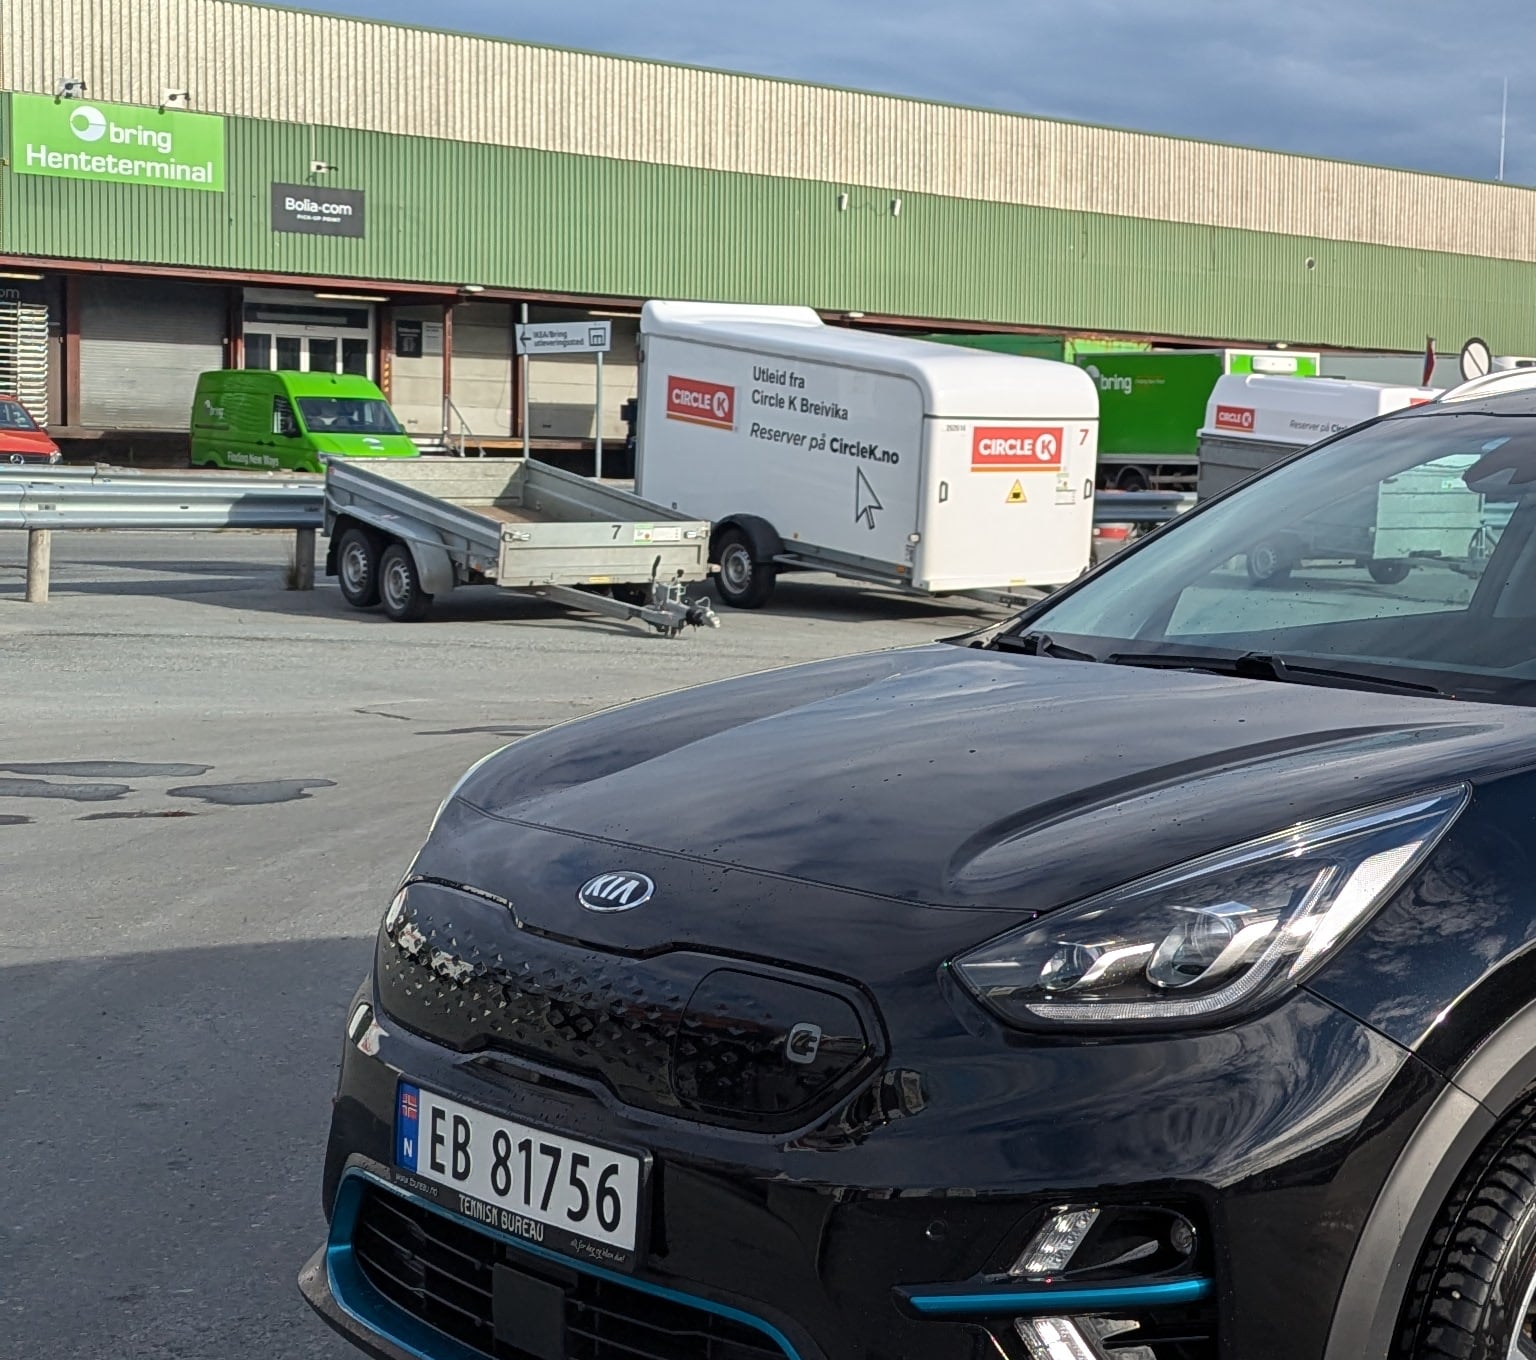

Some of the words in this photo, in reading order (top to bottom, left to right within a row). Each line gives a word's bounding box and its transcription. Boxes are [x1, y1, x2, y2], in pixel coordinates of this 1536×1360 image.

[109, 122, 172, 154] bring
[26, 143, 213, 184] Henteterminal
[753, 366, 786, 386] Utleid
[789, 371, 805, 389] fra
[1100, 374, 1132, 395] bring
[671, 388, 711, 411] CIRCLE
[751, 389, 785, 409] Circle
[788, 396, 797, 412] K
[800, 399, 848, 421] Breivika
[750, 422, 807, 446] Reserver
[808, 433, 826, 452] på
[830, 437, 899, 464] CircleK.no
[978, 438, 1033, 456] CIRCLE
[1079, 429, 1090, 446] 7
[611, 525, 622, 540] 7
[585, 875, 640, 904] KIA
[403, 1138, 413, 1158] N
[430, 1105, 472, 1182] EB
[491, 1129, 622, 1233] 81756
[459, 1193, 499, 1227] TEKNISK
[501, 1211, 545, 1242] BUREAU
